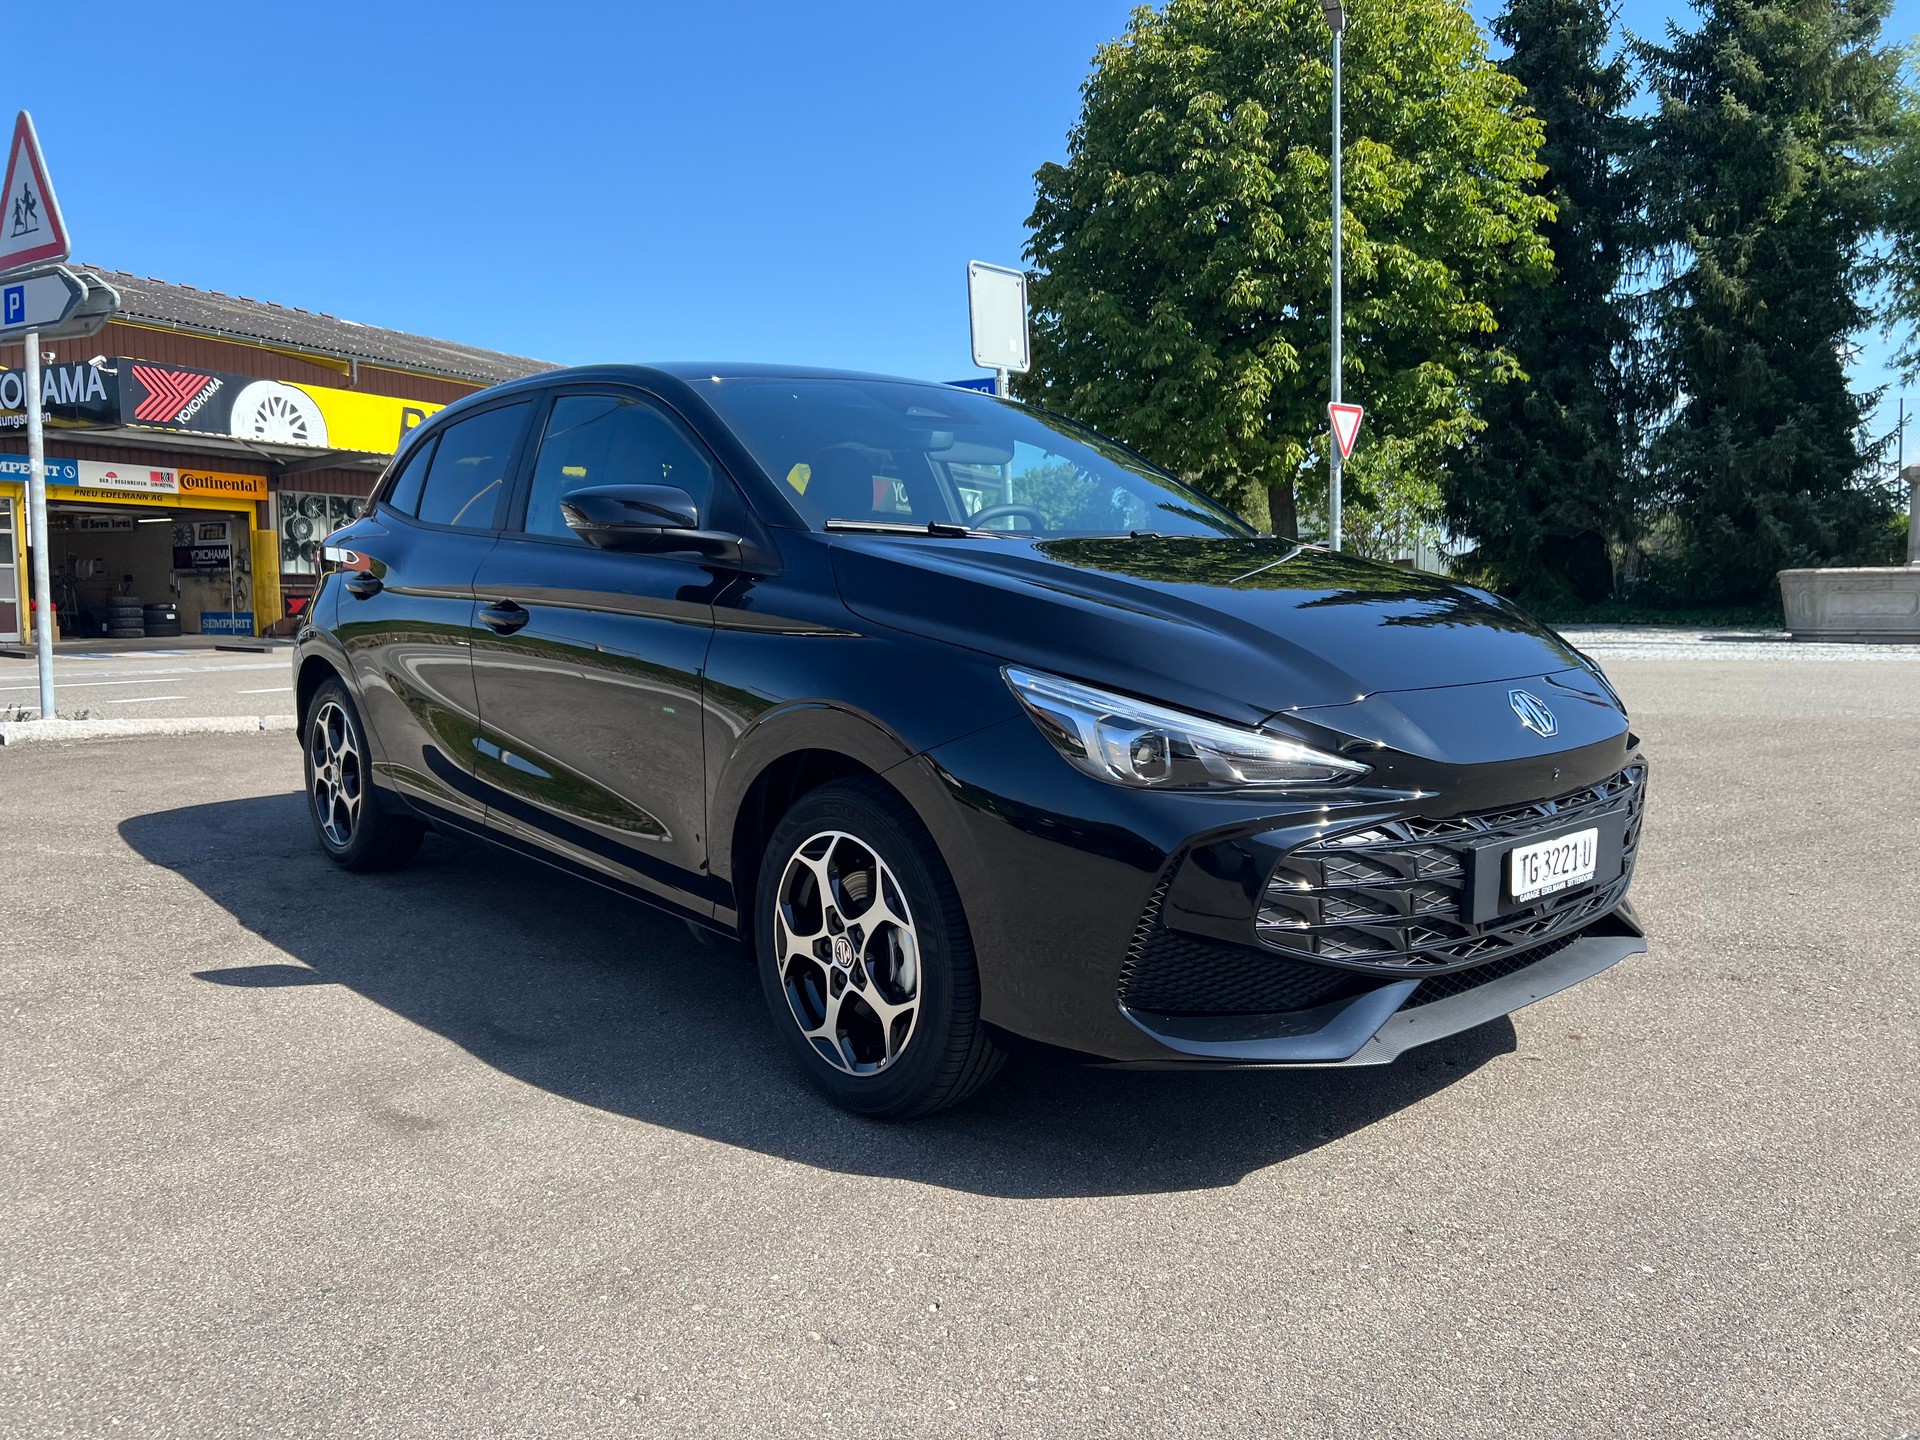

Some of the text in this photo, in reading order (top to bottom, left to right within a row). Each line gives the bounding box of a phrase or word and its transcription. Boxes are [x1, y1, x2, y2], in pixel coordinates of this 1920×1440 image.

[9, 293, 20, 319] P
[175, 378, 223, 424] YOKOHAMA
[74, 489, 163, 502] PNEU EDELMANN AG
[180, 473, 258, 492] Continental
[190, 549, 230, 560] YOKOHAMA
[1513, 693, 1553, 733] MG
[1519, 871, 1594, 903] GARAGE EDELMANN SITTERDORF
